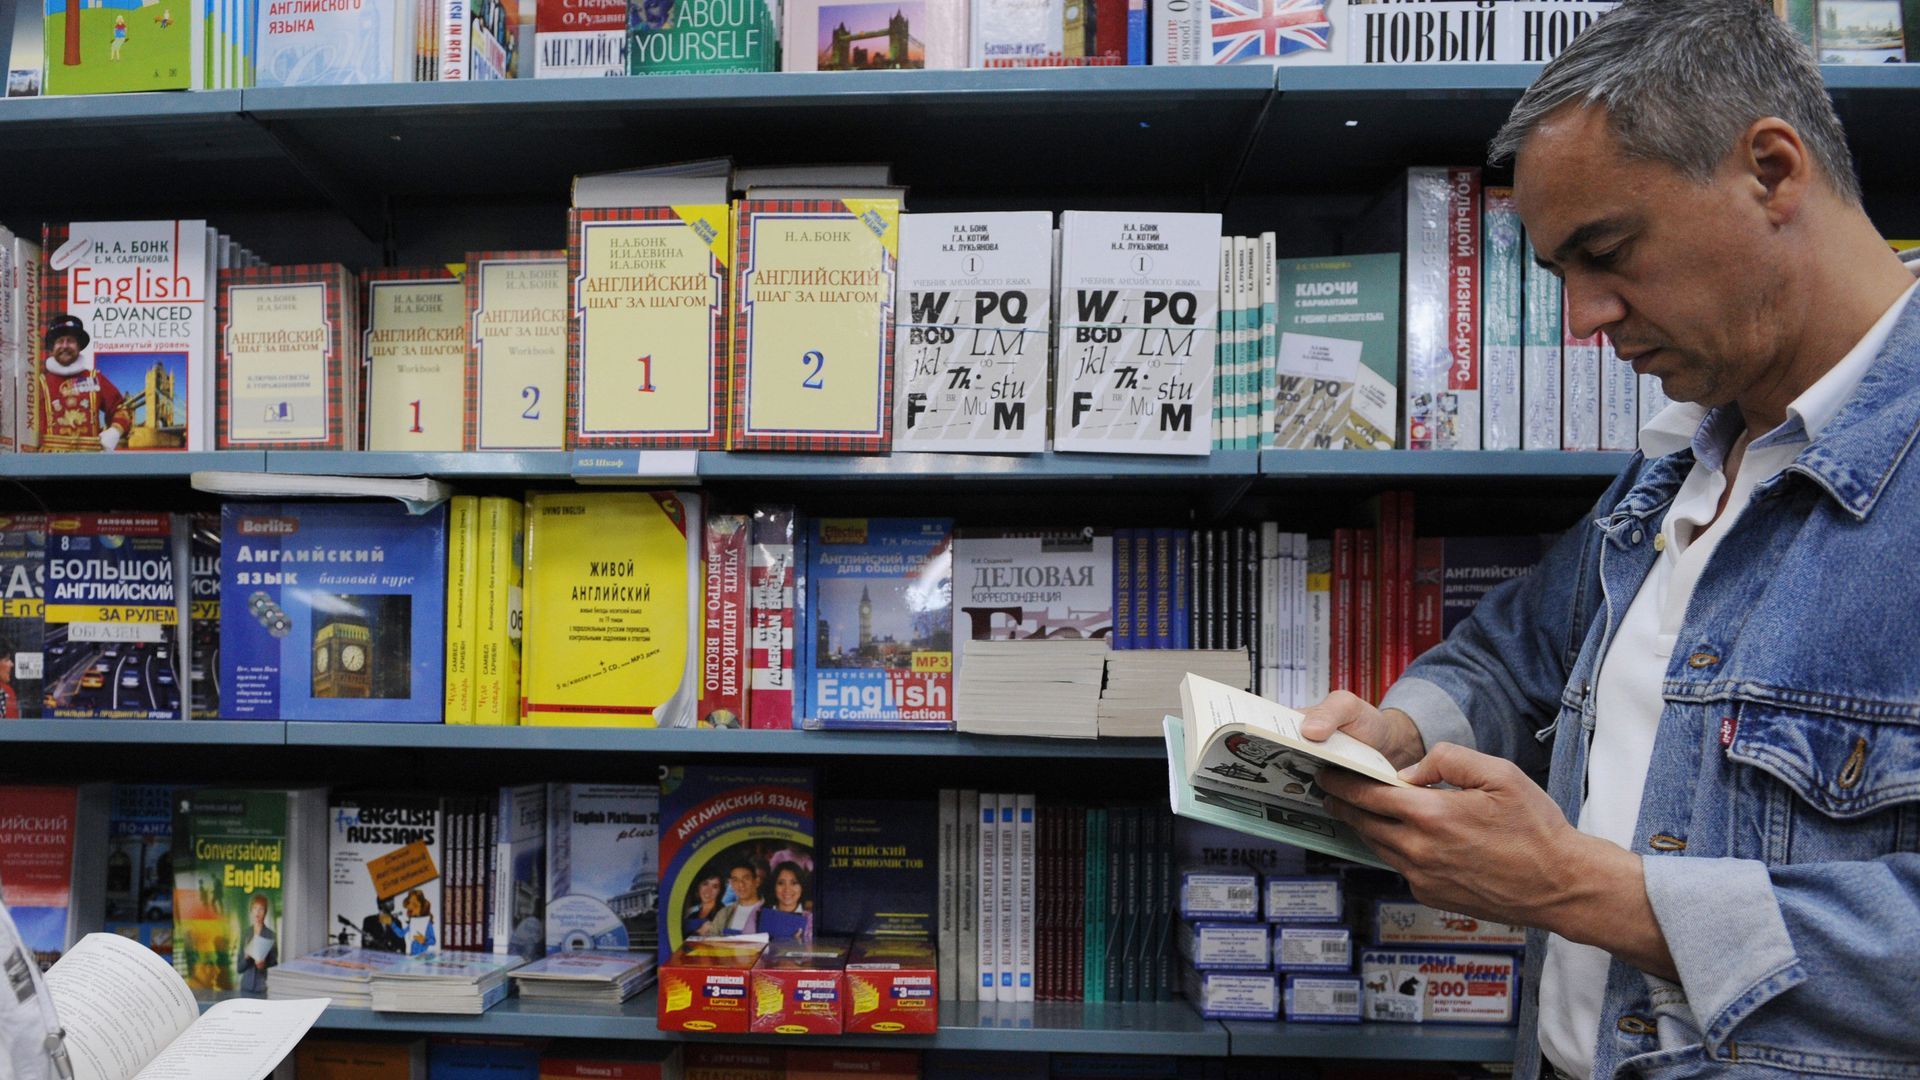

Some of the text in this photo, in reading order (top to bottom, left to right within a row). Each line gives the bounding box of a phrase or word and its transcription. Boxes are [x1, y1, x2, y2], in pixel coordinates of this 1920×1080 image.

[676, 0, 757, 28] ABOUT
[268, 19, 315, 34] ЯЗЫКА
[1364, 0, 1498, 63] НОВЫЙ
[447, 24, 463, 64] IN REAL
[635, 29, 760, 63] YOURSELF
[1178, 19, 1190, 61] уроков
[970, 224, 988, 233] БОНК
[1139, 223, 1158, 232] БОНК
[95, 241, 108, 253] Н.
[113, 241, 127, 253] А.
[131, 241, 168, 253] БОНК
[95, 255, 169, 264] Е. М. САЛТЫКОВА
[586, 273, 707, 293] АНГЛИЙСКИЙ
[754, 267, 879, 286] АНГЛИЙСКИЙ
[1456, 170, 1471, 382] БОЛЬШОЙ БИЗНЕС-КУРС
[73, 267, 191, 304] English
[1295, 281, 1359, 297] КЛЮЧИ
[94, 296, 112, 305] FOR
[588, 295, 707, 309] ШАГ ЗА ШАГОМ
[756, 290, 878, 303] ШАГ ЗА ШАГОМ
[92, 306, 192, 321] ADVANCED
[93, 322, 191, 339] LEARNERS
[232, 328, 325, 344] АНГЛИЙСКИЙ
[372, 325, 464, 343] АНГЛИЙСКИЙ
[484, 327, 532, 337] ШАГ ЗА
[25, 259, 36, 431] ЖИВОЙ АНГЛИЙСКИЙ
[93, 340, 190, 352] Продвинутый уровень
[237, 343, 319, 353] ШАГ ЗА ШАГОМ
[372, 345, 464, 356] ШАГ ЗА ШАГОМ
[508, 345, 555, 356] Workbook
[397, 364, 441, 373] Workbook
[637, 354, 656, 393] 1
[802, 350, 825, 390] 2
[1585, 350, 1597, 414] English for
[521, 386, 541, 420] 2
[1620, 398, 1633, 415] for
[409, 400, 424, 433] 1
[1606, 412, 1618, 441] Care
[242, 519, 293, 532] Berlitz
[237, 545, 385, 563] Английский
[819, 552, 904, 566] Английский
[50, 556, 172, 581] БОЛЬШОЙ
[589, 559, 634, 577] ЖИВОЙ
[837, 564, 862, 575] для
[319, 572, 377, 585] базовый
[381, 575, 414, 587] курс
[971, 565, 1095, 592] ДЕЛОВАЯ
[54, 581, 174, 601] АНГЛИЙСКИЙ
[571, 584, 651, 602] АНГЛИЙСКИЙ
[971, 590, 1062, 603] КОРРЕСПОНДЕНЦИЯ
[98, 609, 175, 622] ЗА РУЛЕМ
[1118, 591, 1129, 637] ENGLISH
[1137, 591, 1148, 637] ENGLISH
[1157, 591, 1168, 637] ENGLISH
[1311, 594, 1320, 622] english
[706, 554, 721, 691] БЫСТРО И ВЕСЕЛО
[722, 548, 738, 697] УЧИТЕ АНГЛИЙСКИЙ
[767, 615, 783, 686] AMERICAN
[915, 655, 949, 667] MP3
[817, 678, 947, 712] English
[816, 707, 946, 720] for Communication
[357, 808, 436, 826] ENGLISH
[677, 791, 808, 840] АНГЛИЙСКИЙ ЯЗЫК
[16, 834, 66, 845] РУССКИХ
[347, 826, 435, 845] RUSSIANS
[616, 827, 659, 843] plus
[195, 839, 281, 862] Conversational
[831, 844, 906, 857] АНГЛИЙСКИЙ
[223, 864, 281, 894] English
[1428, 981, 1465, 997] 300
